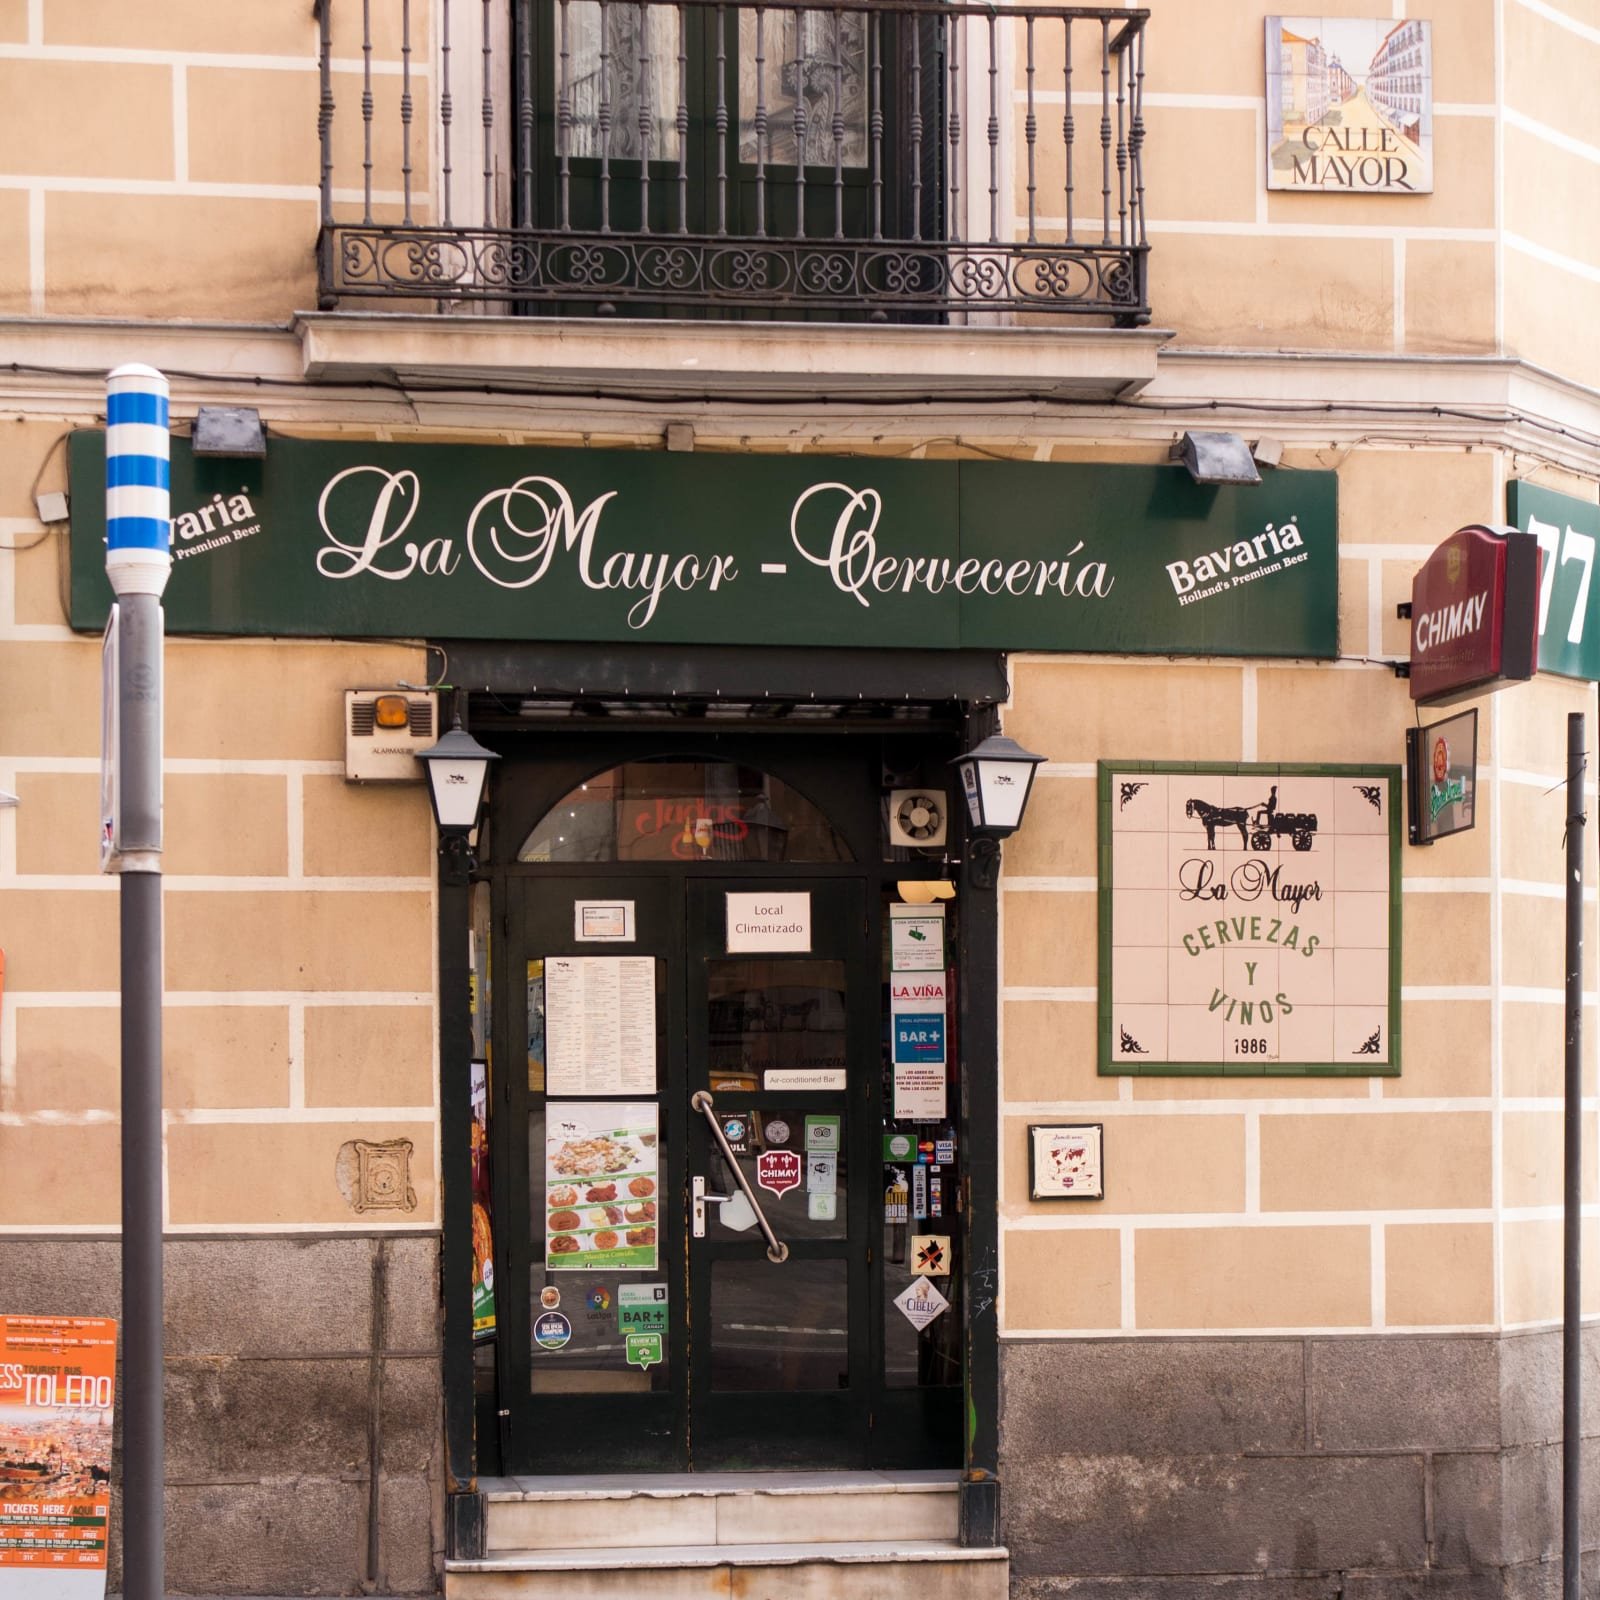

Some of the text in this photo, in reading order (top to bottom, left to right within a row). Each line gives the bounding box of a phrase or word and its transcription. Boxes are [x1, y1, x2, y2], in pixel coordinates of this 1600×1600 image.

[1302, 126, 1399, 152] CALLE
[1291, 155, 1416, 191] MAYOR
[175, 523, 262, 560] Premium Beer
[315, 465, 461, 581] La
[466, 475, 738, 631] Mayor
[789, 481, 1116, 608] Cervecería
[1178, 552, 1309, 607] Holland's Premium Beer
[1527, 513, 1596, 645] 77
[1415, 591, 1488, 653] CHIMAY
[1178, 858, 1323, 915] La Mayor
[754, 904, 784, 916] Local
[735, 923, 803, 934] Climatizado
[1181, 915, 1321, 958] CERVEZAS
[1244, 961, 1259, 986] Y
[893, 984, 944, 997] LA VIÑA
[1207, 987, 1294, 1026] VINOS
[1234, 1038, 1268, 1055] 1986
[769, 1075, 836, 1084] Air-conditioned Bar
[730, 1144, 747, 1152] ULL
[760, 1169, 798, 1178] CHIMAY
[24, 1365, 61, 1375] TOURIST
[64, 1366, 82, 1375] BUS
[22, 1374, 112, 1409] TOLEDO
[3, 1504, 39, 1514] TICKETS
[42, 1504, 65, 1515] HERE
